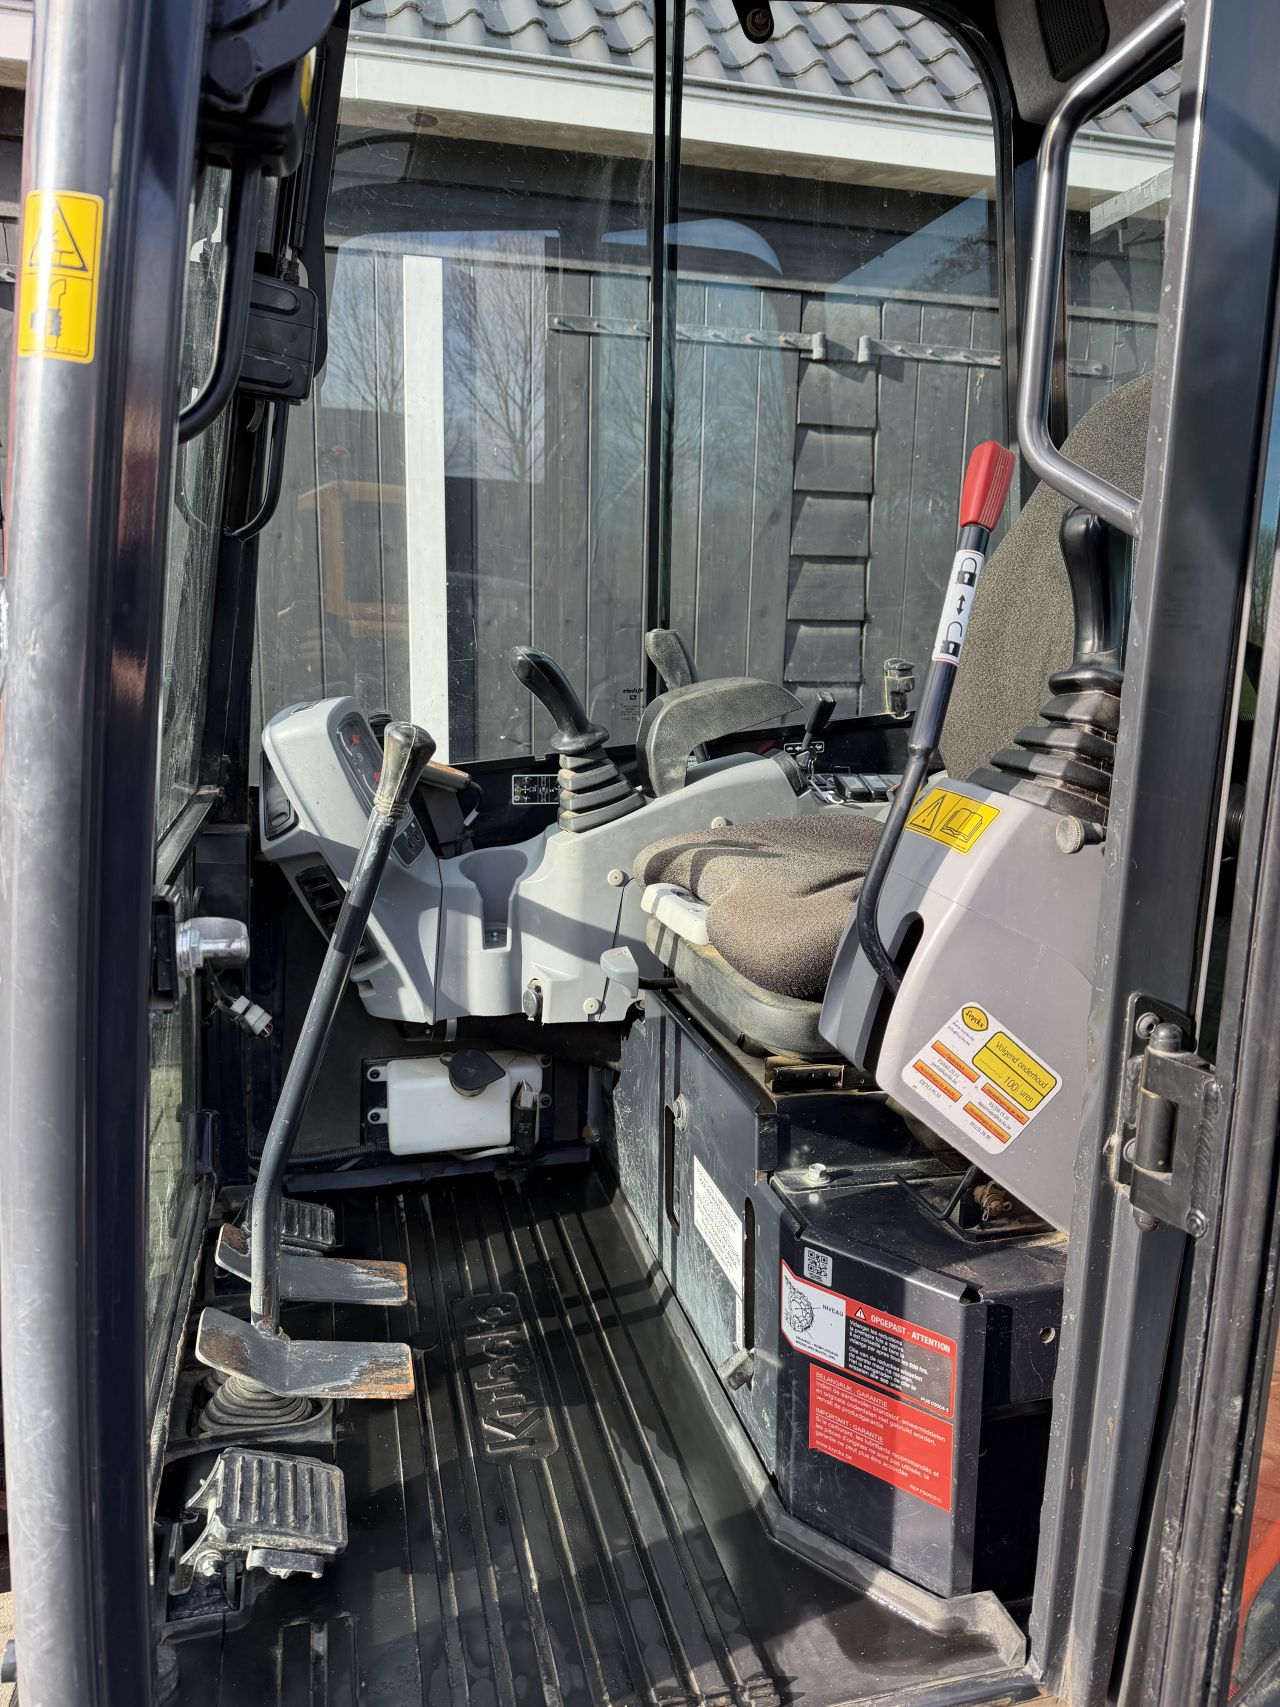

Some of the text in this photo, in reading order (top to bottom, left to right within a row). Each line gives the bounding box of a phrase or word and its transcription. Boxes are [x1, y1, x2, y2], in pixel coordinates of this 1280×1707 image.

[995, 1040, 1048, 1088] Volgend onderhoud
[1003, 1076, 1033, 1103] 100 uren
[822, 1304, 843, 1316] NIVEAU
[870, 1314, 905, 1333] OPGEPAST
[911, 1331, 950, 1352] ATTENTION
[815, 1381, 831, 1390] Indien
[900, 1369, 922, 1381] wisselen
[815, 1372, 851, 1390] BELANGRIJK
[856, 1389, 887, 1407] GARANTIE
[815, 1407, 848, 1424] IMPORTANT
[852, 1424, 883, 1442] GARANTIE
[878, 1415, 888, 1423] niet
